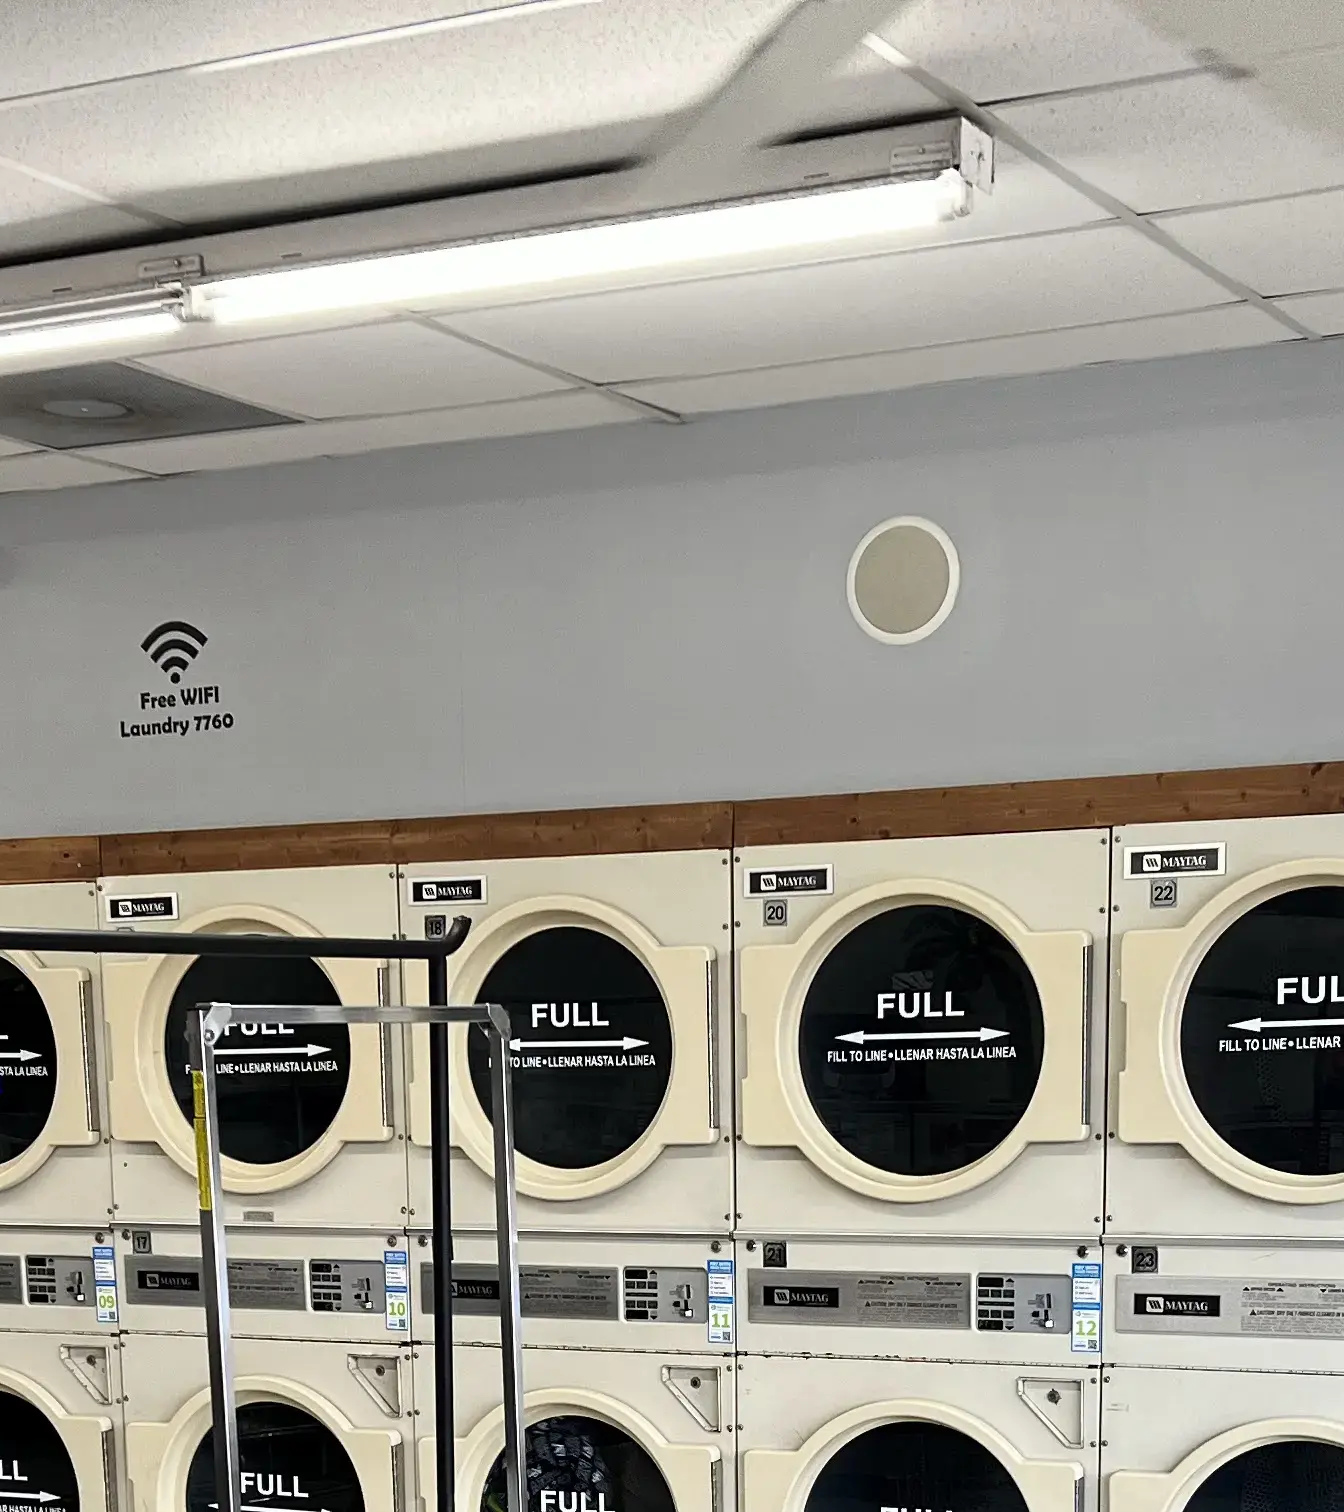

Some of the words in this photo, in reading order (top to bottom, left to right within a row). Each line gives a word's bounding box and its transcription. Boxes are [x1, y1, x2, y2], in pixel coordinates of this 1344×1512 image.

[140, 692, 176, 710] Free
[180, 686, 220, 706] WIFI
[120, 716, 190, 738] Laundry
[193, 713, 234, 732] 7760
[1162, 855, 1207, 869] MAYTAG
[777, 876, 816, 889] MAYTAG
[438, 885, 473, 897] MAYTAG
[1154, 886, 1173, 901] 22
[131, 902, 165, 913] MAYTAG
[766, 905, 784, 921] 20
[431, 918, 443, 936] 18
[878, 991, 964, 1018] FULL
[532, 1003, 609, 1027] FULL
[224, 1022, 295, 1036] FULL
[1218, 1040, 1242, 1051] FILL
[1243, 1039, 1259, 1050] TO
[584, 1056, 614, 1066] HASTA
[615, 1056, 627, 1066] LA
[628, 1055, 655, 1065] LINEA
[827, 1051, 847, 1062] FILL
[848, 1051, 862, 1061] TO
[935, 1048, 969, 1059] HASTA
[970, 1048, 984, 1058] LA
[986, 1047, 1016, 1058] LINEA
[272, 1062, 300, 1072] HASTA
[300, 1062, 312, 1071] LA
[312, 1061, 338, 1071] LINEA
[136, 1236, 149, 1250] 17
[1137, 1252, 1155, 1270] 23
[99, 1295, 115, 1309] 09
[791, 1293, 829, 1304] MAYTAG
[1166, 1299, 1208, 1312] MAYTAG
[389, 1301, 405, 1316] 10
[712, 1312, 731, 1328] 11
[1076, 1320, 1098, 1337] 12
[240, 1472, 309, 1498] FULL
